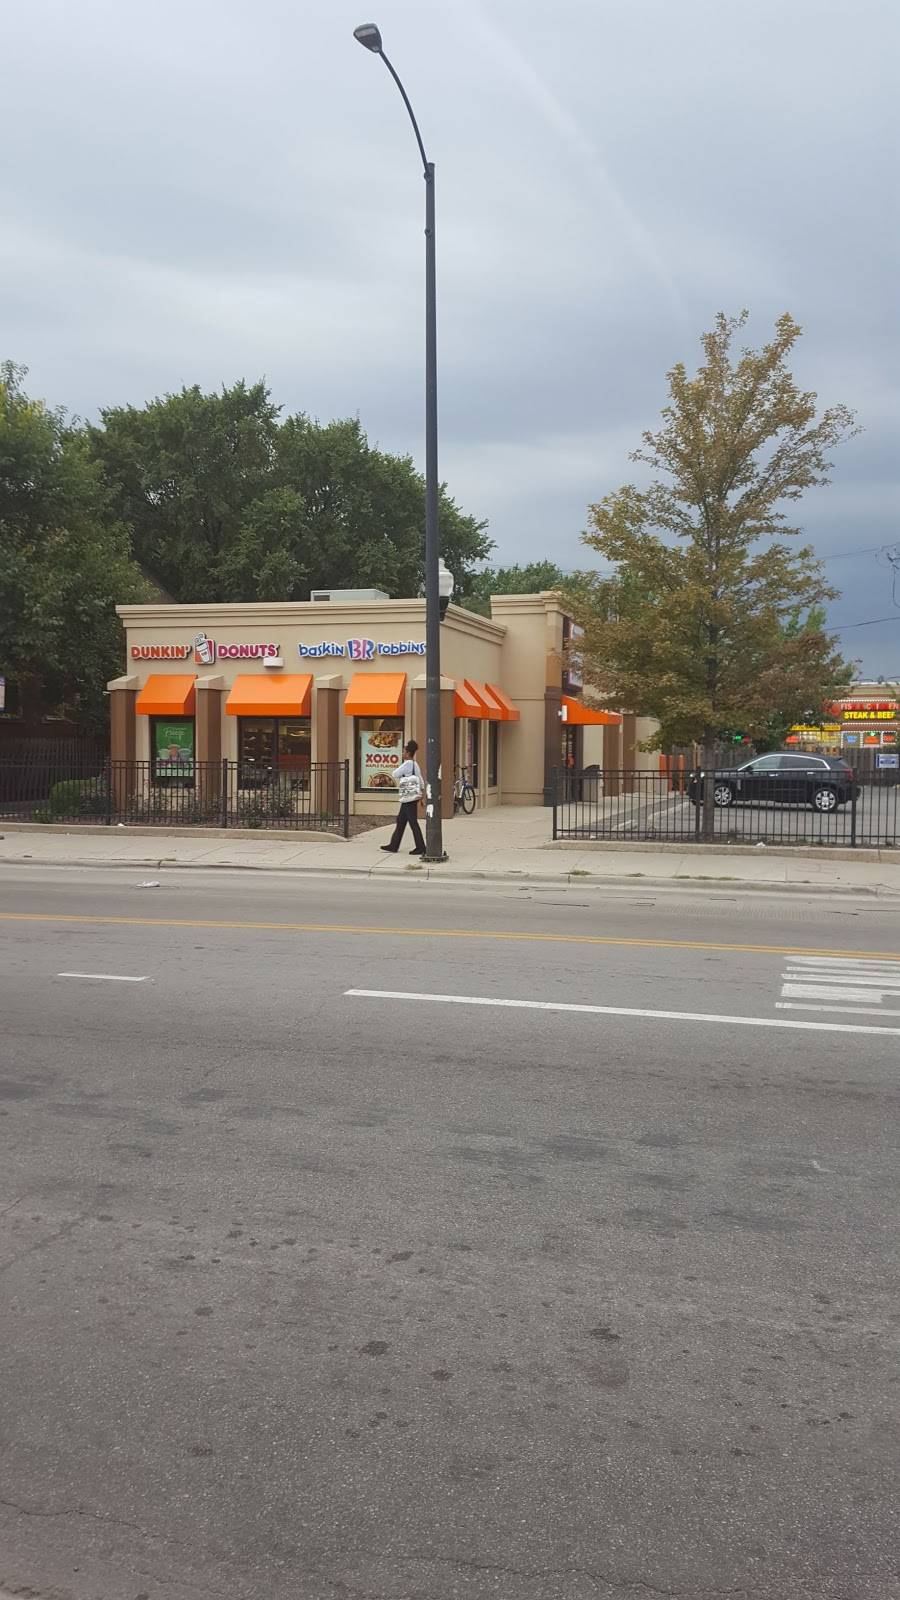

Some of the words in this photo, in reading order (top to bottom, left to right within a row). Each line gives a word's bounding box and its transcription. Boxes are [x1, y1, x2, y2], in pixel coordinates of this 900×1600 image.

[130, 645, 190, 658] DUNKIN'
[217, 644, 277, 657] DONUTS
[298, 641, 344, 656] baskin
[347, 639, 375, 659] BR
[377, 641, 425, 654] robbins
[844, 711, 868, 719] STEAK
[870, 711, 875, 719] &
[877, 711, 896, 719] BEEF
[366, 753, 399, 764] XOXO
